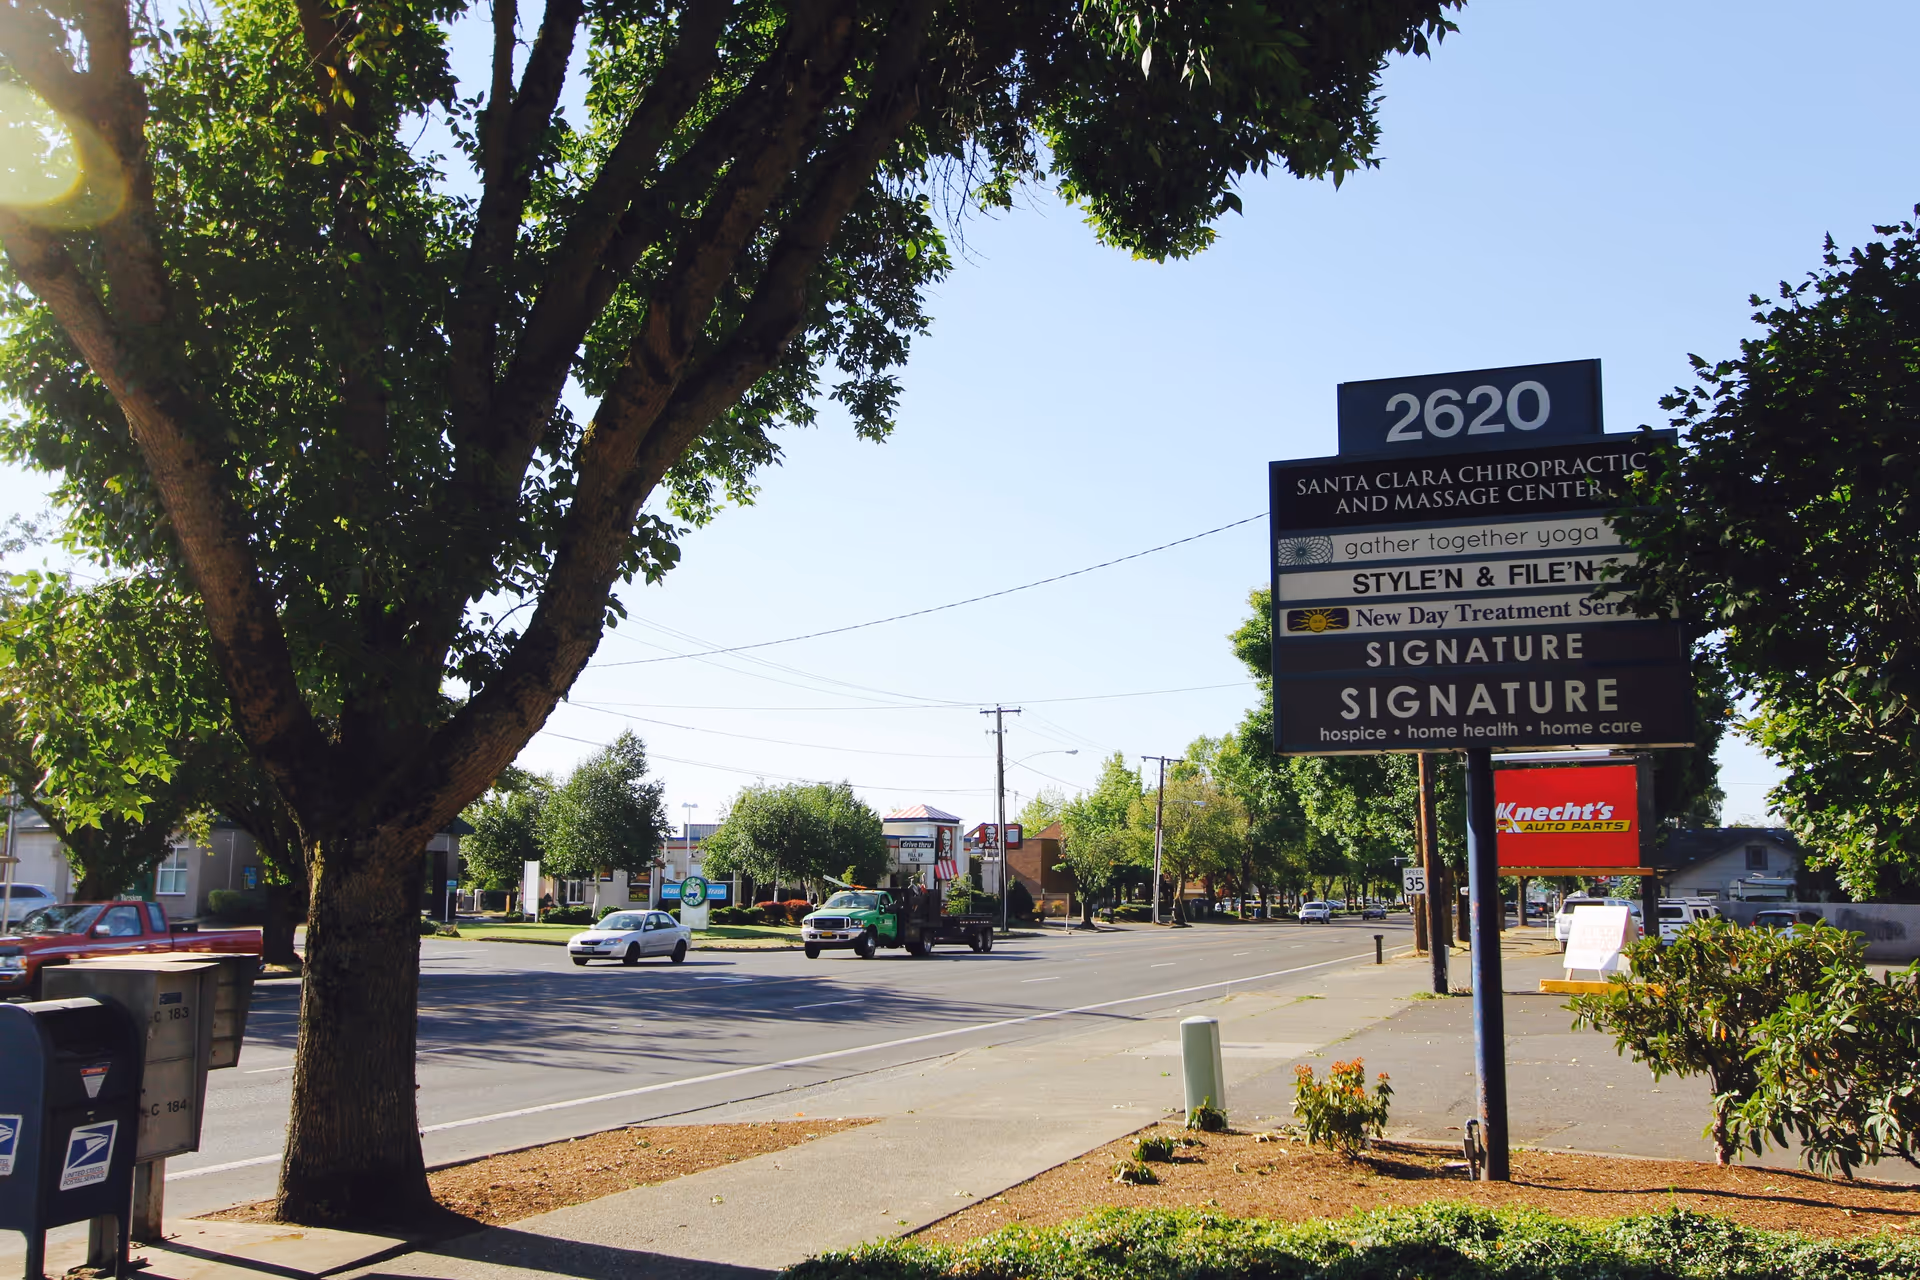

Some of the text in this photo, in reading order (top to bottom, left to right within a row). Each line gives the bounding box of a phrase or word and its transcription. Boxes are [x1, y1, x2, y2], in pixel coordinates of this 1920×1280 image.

[1385, 380, 1551, 443] 2620
[1297, 452, 1647, 496] SANTA CLARA CHIROPRACTIC
[1335, 480, 1603, 515] AND MASSAGE CENTER
[1345, 525, 1599, 560] gather together yoga
[1352, 567, 1464, 595] STYLE'N
[1476, 566, 1495, 587] &
[1356, 597, 1618, 629] New Day Treatment Ser
[1365, 633, 1584, 668] SIGNATURE
[1339, 678, 1619, 720] SIGNATURE
[1320, 719, 1643, 743] hospice home health home care
[1496, 802, 1614, 832] Knecht's
[1524, 822, 1625, 831] AUTO PARTS
[1406, 877, 1425, 892] 35
[168, 1006, 189, 1020] 183
[167, 1099, 187, 1113] 184
